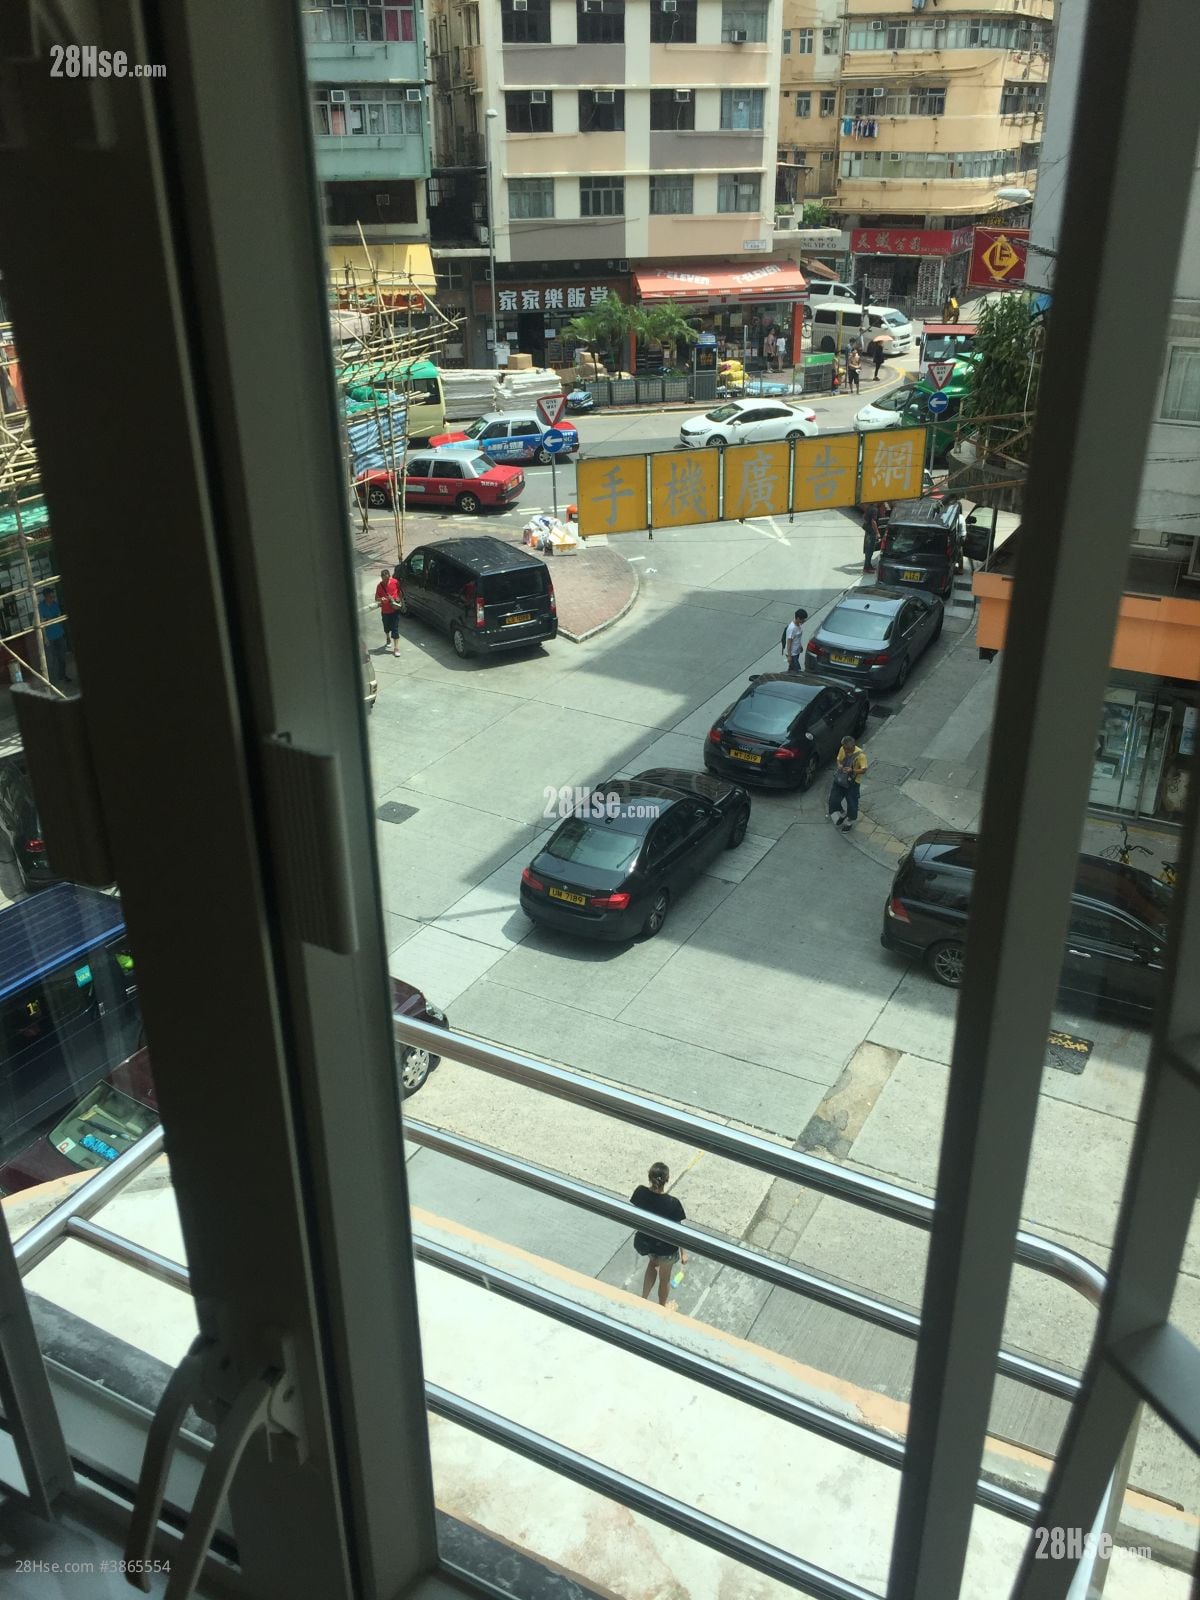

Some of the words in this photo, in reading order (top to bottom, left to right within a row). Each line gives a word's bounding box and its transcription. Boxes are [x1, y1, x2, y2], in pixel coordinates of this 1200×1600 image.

[498, 286, 609, 311] 家家樂飯堂
[590, 439, 914, 527] 手機廣告網
